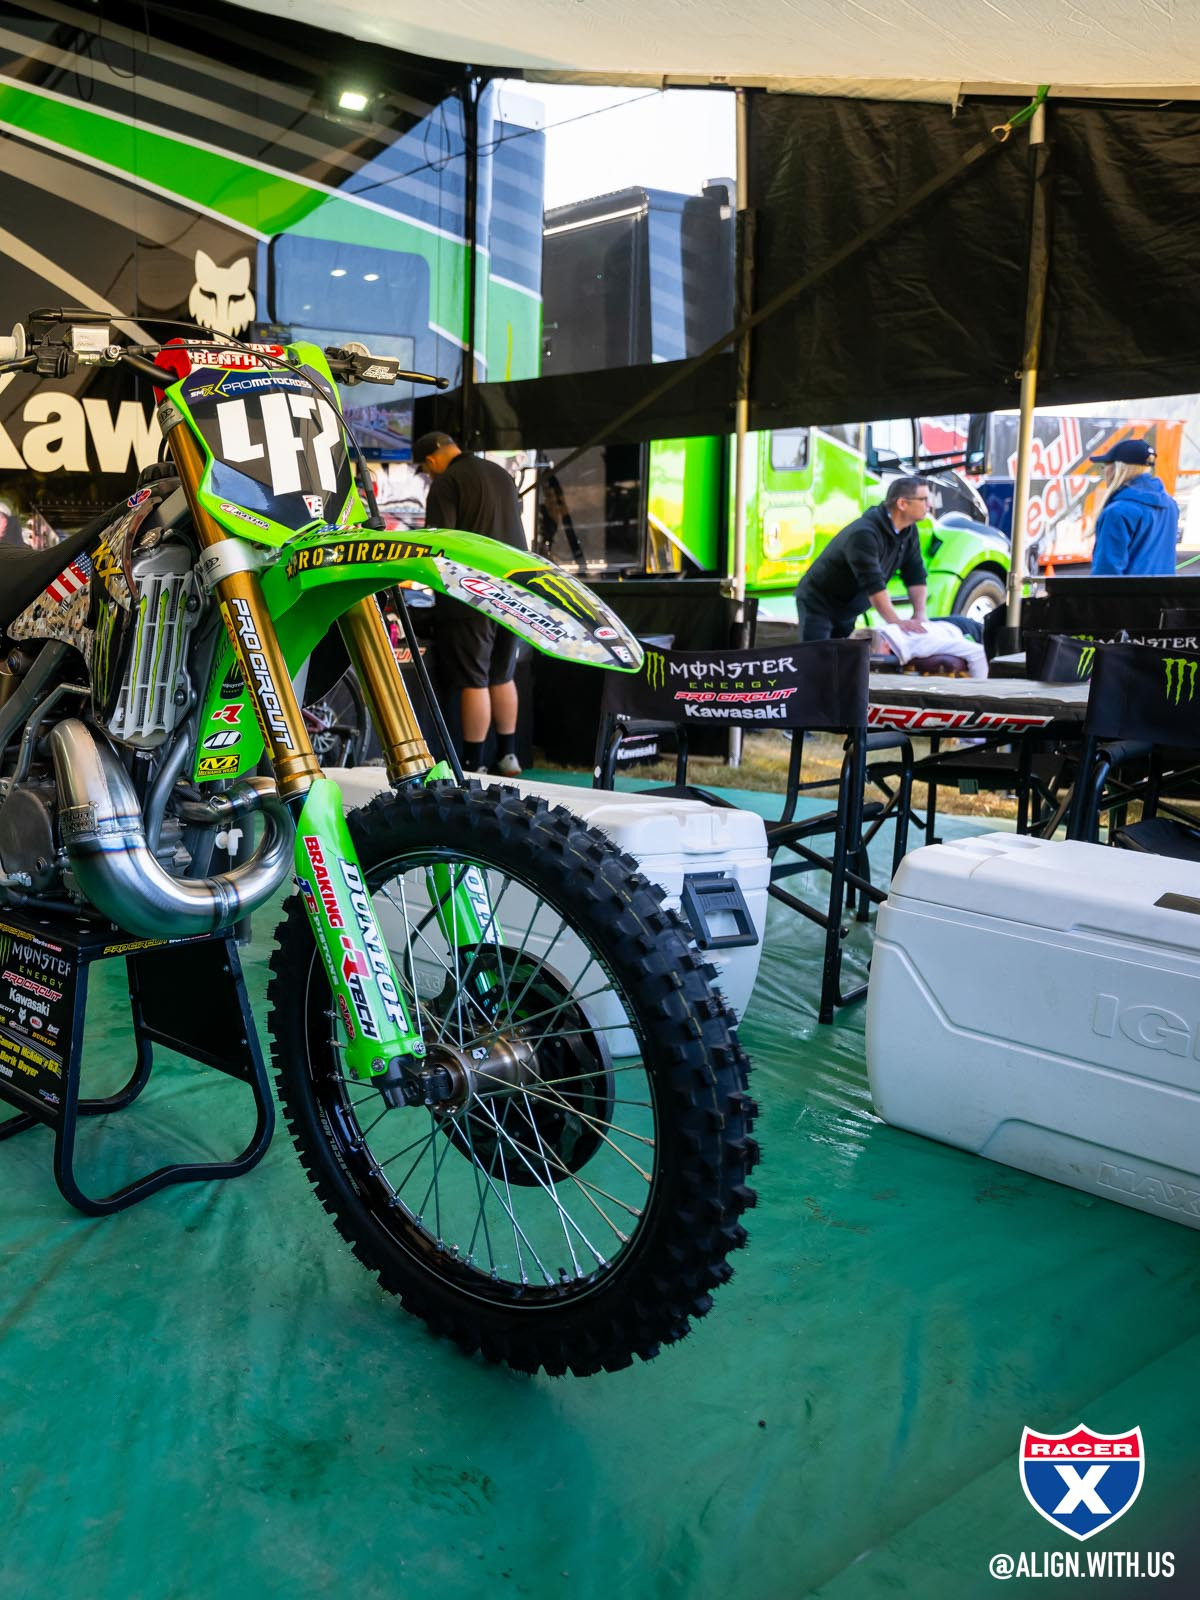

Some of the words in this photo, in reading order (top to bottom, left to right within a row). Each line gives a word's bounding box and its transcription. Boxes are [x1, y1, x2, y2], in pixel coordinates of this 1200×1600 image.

[333, 542, 429, 563] CIRCUIT
[231, 598, 263, 651] PRO
[248, 652, 295, 751] CIRCUIT
[669, 656, 799, 681] MONSTER
[673, 690, 716, 703] PRO
[716, 687, 799, 704] CIRCUIT
[689, 679, 778, 690] ENERGY
[684, 703, 788, 720] Kawasaki
[867, 703, 1056, 734] IRCUIT
[616, 743, 658, 762] Kawasaki
[302, 835, 345, 929] BRAKING
[313, 912, 341, 987] PISTONS
[336, 856, 411, 1034] DUNLOP
[1, 969, 26, 987] PRO
[22, 978, 64, 1003] CIRCUIT
[18, 964, 64, 990] ENERGY
[8, 986, 51, 1017] Kawasaki
[31, 1031, 57, 1047] DUNLOP
[0, 1050, 18, 1067] Derik
[17, 1060, 39, 1078] Dwyer
